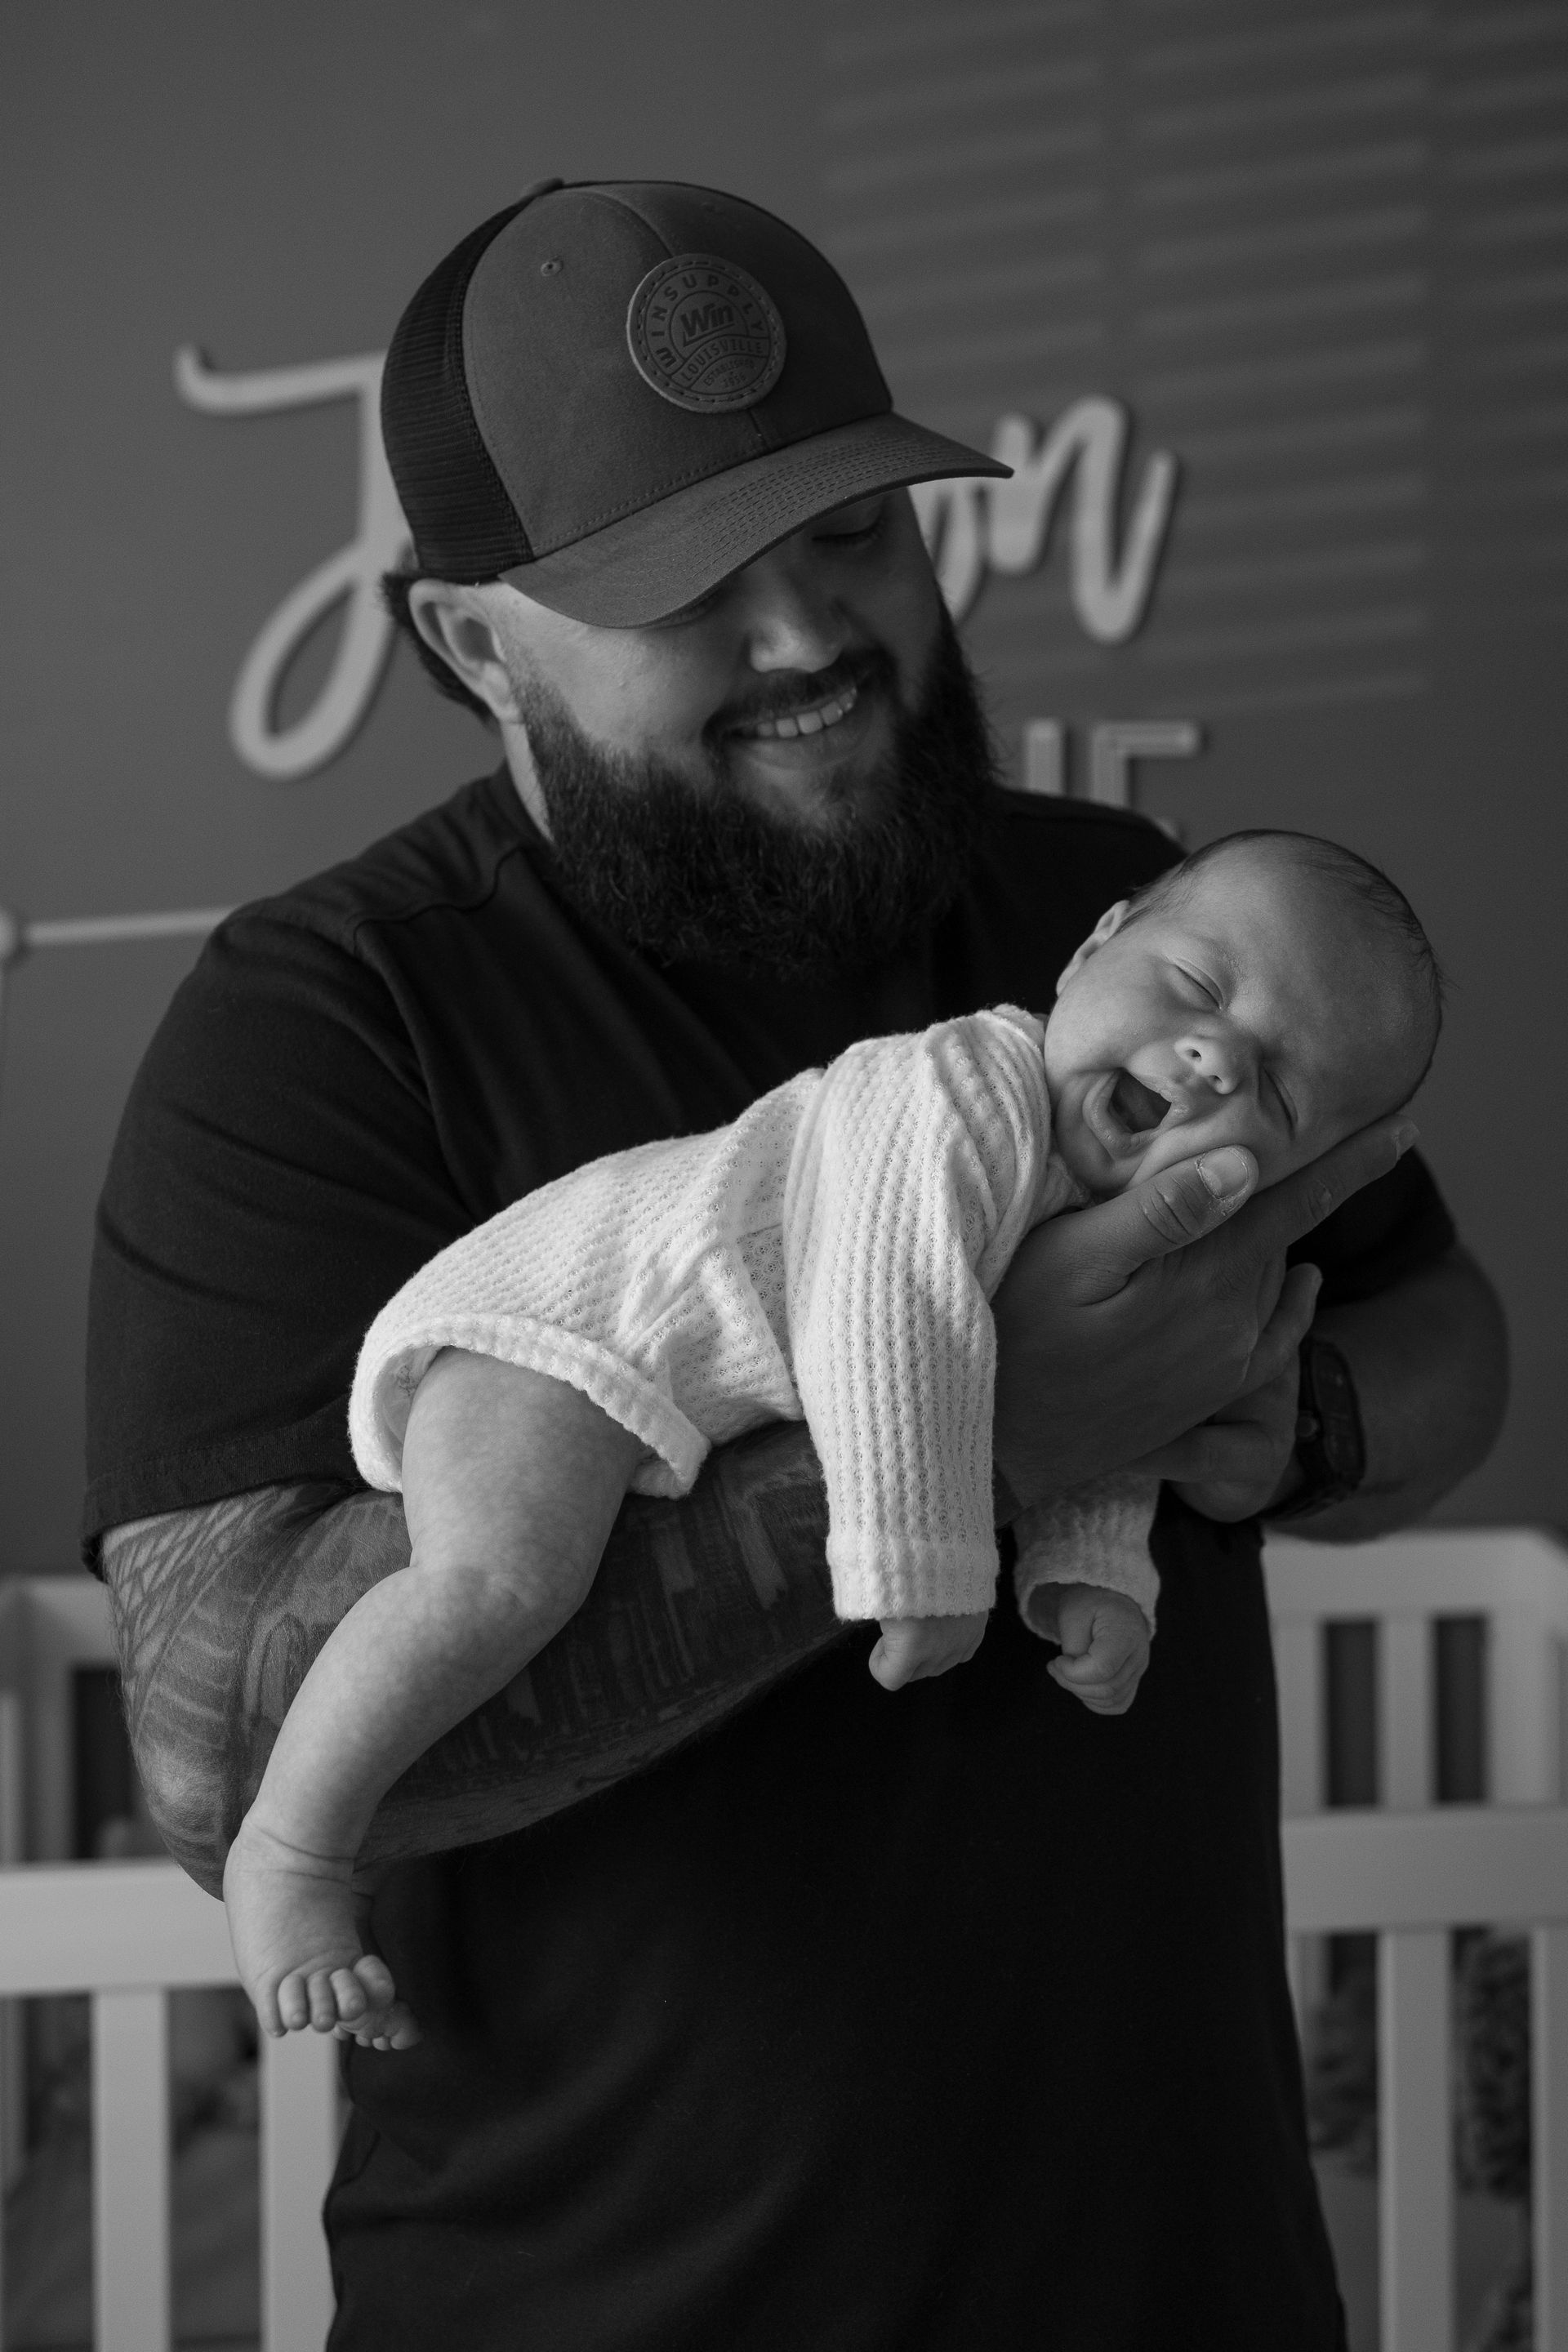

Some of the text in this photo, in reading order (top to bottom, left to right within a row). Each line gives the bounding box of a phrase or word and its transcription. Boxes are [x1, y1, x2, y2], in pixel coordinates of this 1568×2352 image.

[651, 274, 765, 368] WINSUPPLY
[679, 303, 733, 337] Win
[680, 339, 763, 381] LOUISVILLE
